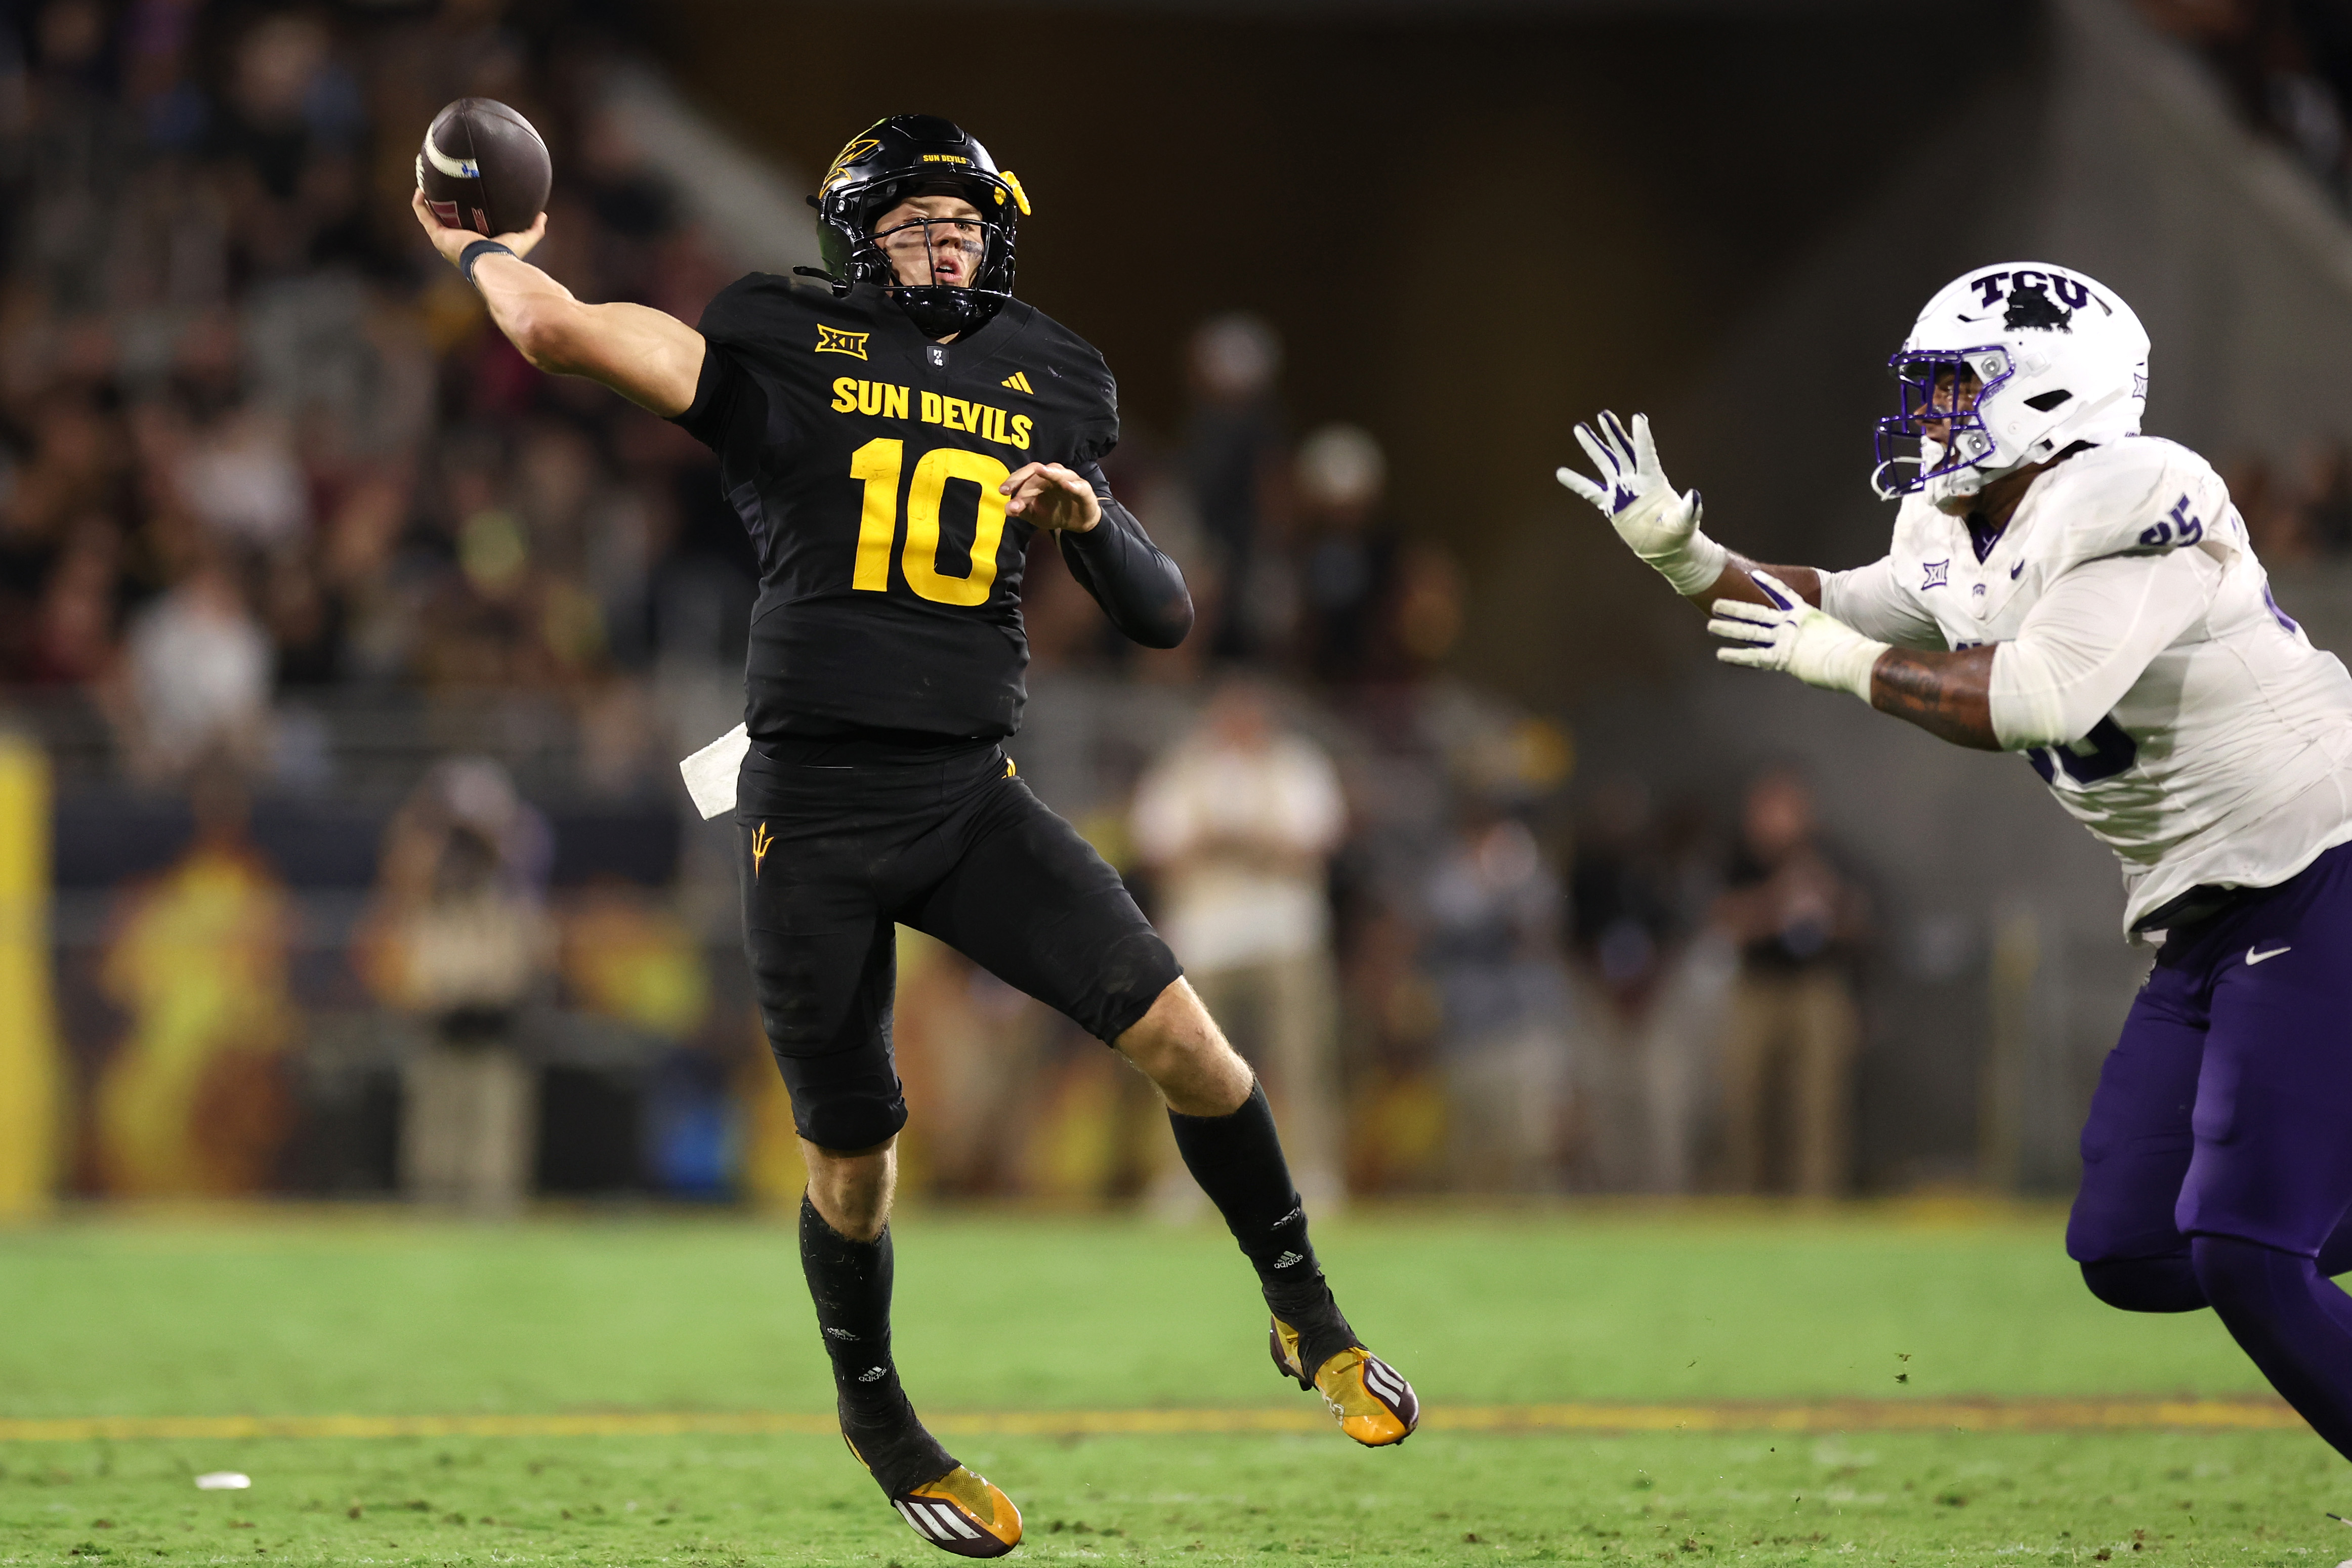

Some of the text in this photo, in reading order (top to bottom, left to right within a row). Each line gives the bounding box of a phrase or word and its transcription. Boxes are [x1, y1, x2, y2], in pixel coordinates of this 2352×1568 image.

[941, 155, 967, 164] DEVILS
[1971, 271, 2090, 310] TCU
[831, 377, 1033, 450] SUN DEVILS
[850, 437, 1012, 606] 10
[1274, 1254, 1303, 1268] adidas
[858, 1367, 887, 1382] adidas
